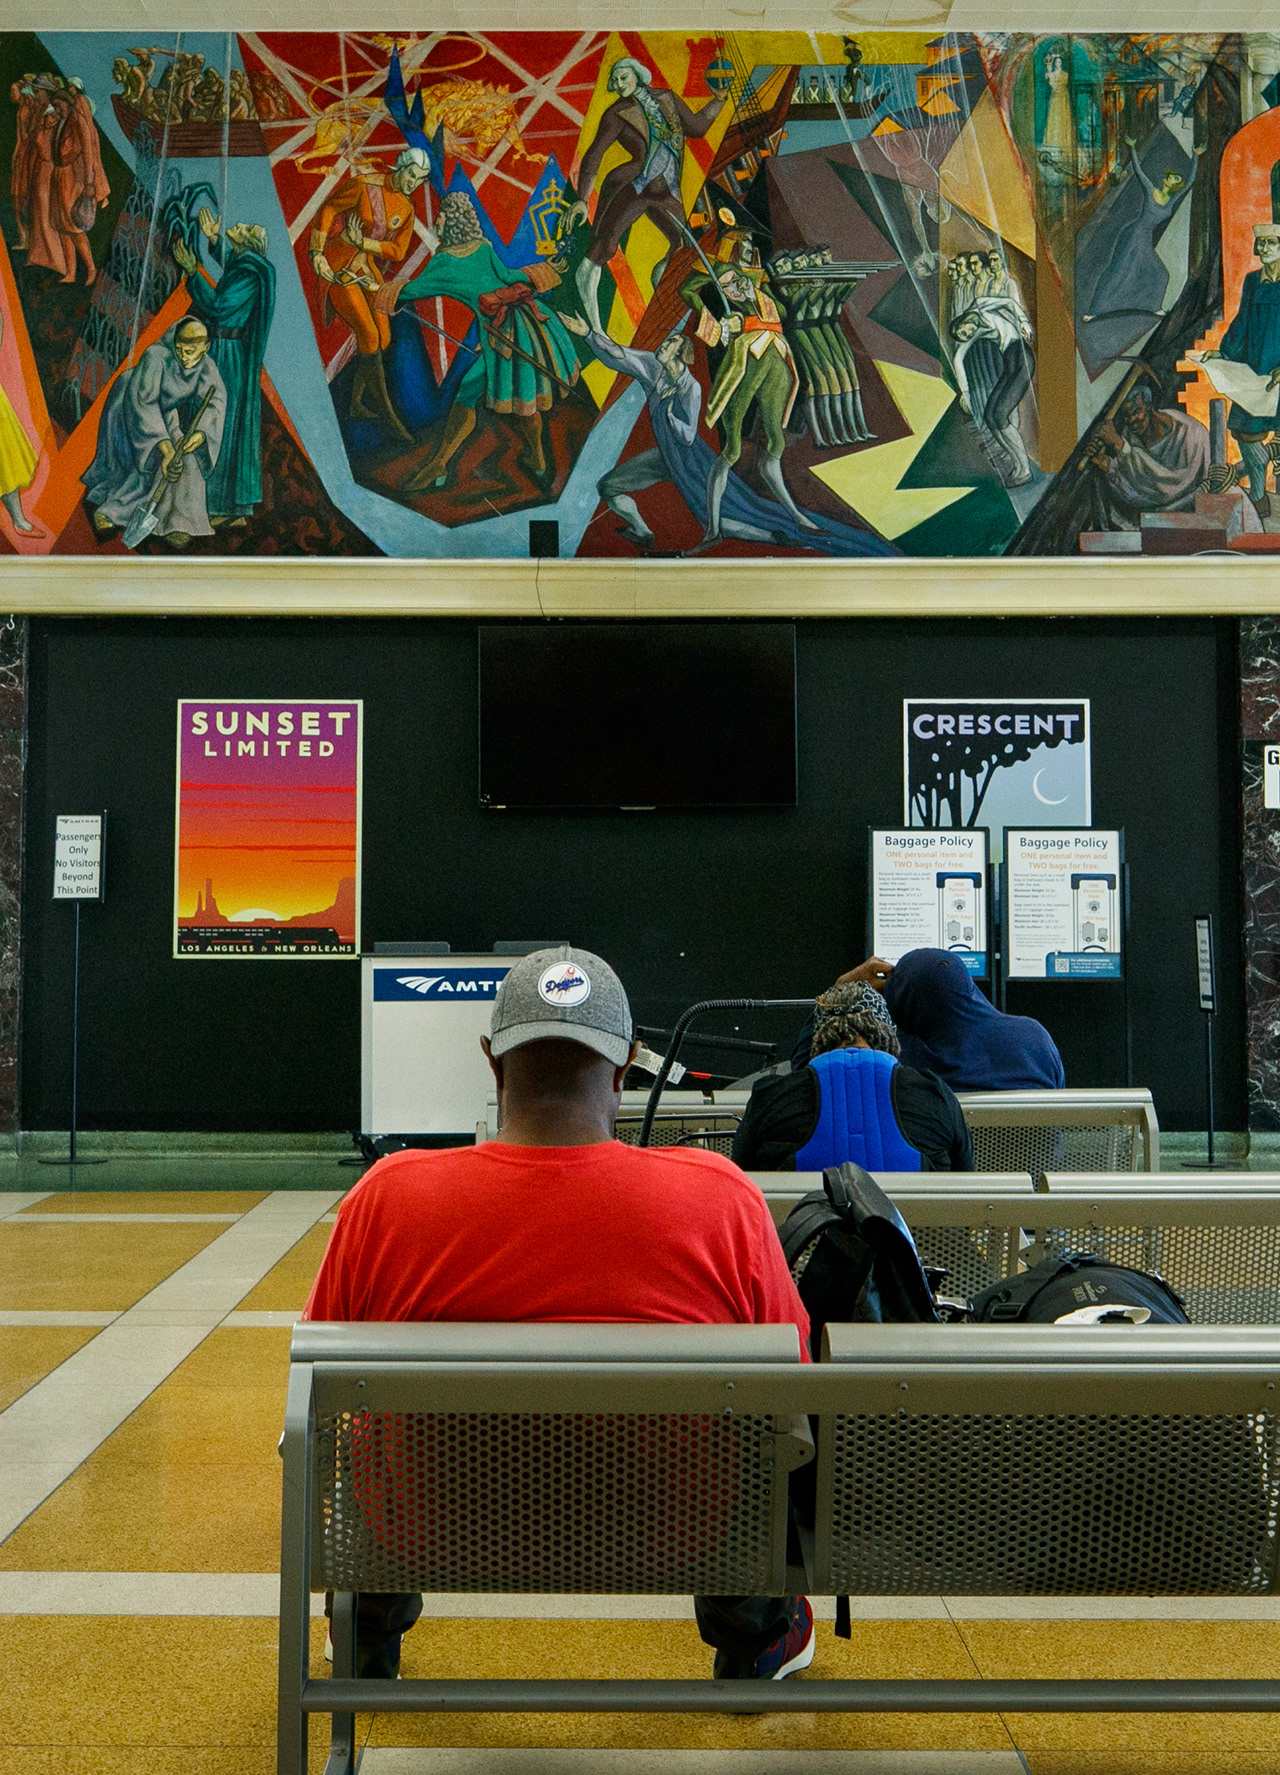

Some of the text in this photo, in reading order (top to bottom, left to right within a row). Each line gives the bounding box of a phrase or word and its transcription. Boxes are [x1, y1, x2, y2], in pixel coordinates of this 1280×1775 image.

[191, 711, 351, 736] SUNSET
[912, 713, 1080, 739] CRESCENT
[204, 740, 335, 757] LIMITED
[885, 836, 974, 849] Baggage Policy
[1020, 837, 1108, 850] Baggage Policy
[68, 846, 88, 856] Only
[885, 851, 974, 860] ONE personal item and
[1020, 852, 1037, 860] ONE
[1039, 852, 1072, 861] personal
[1093, 852, 1108, 860] and
[55, 859, 100, 868] No Visitors
[914, 861, 933, 870] bags
[1049, 862, 1067, 871] bags
[62, 872, 94, 882] Beyond
[56, 885, 98, 894] This Point
[437, 980, 504, 992] AMT
